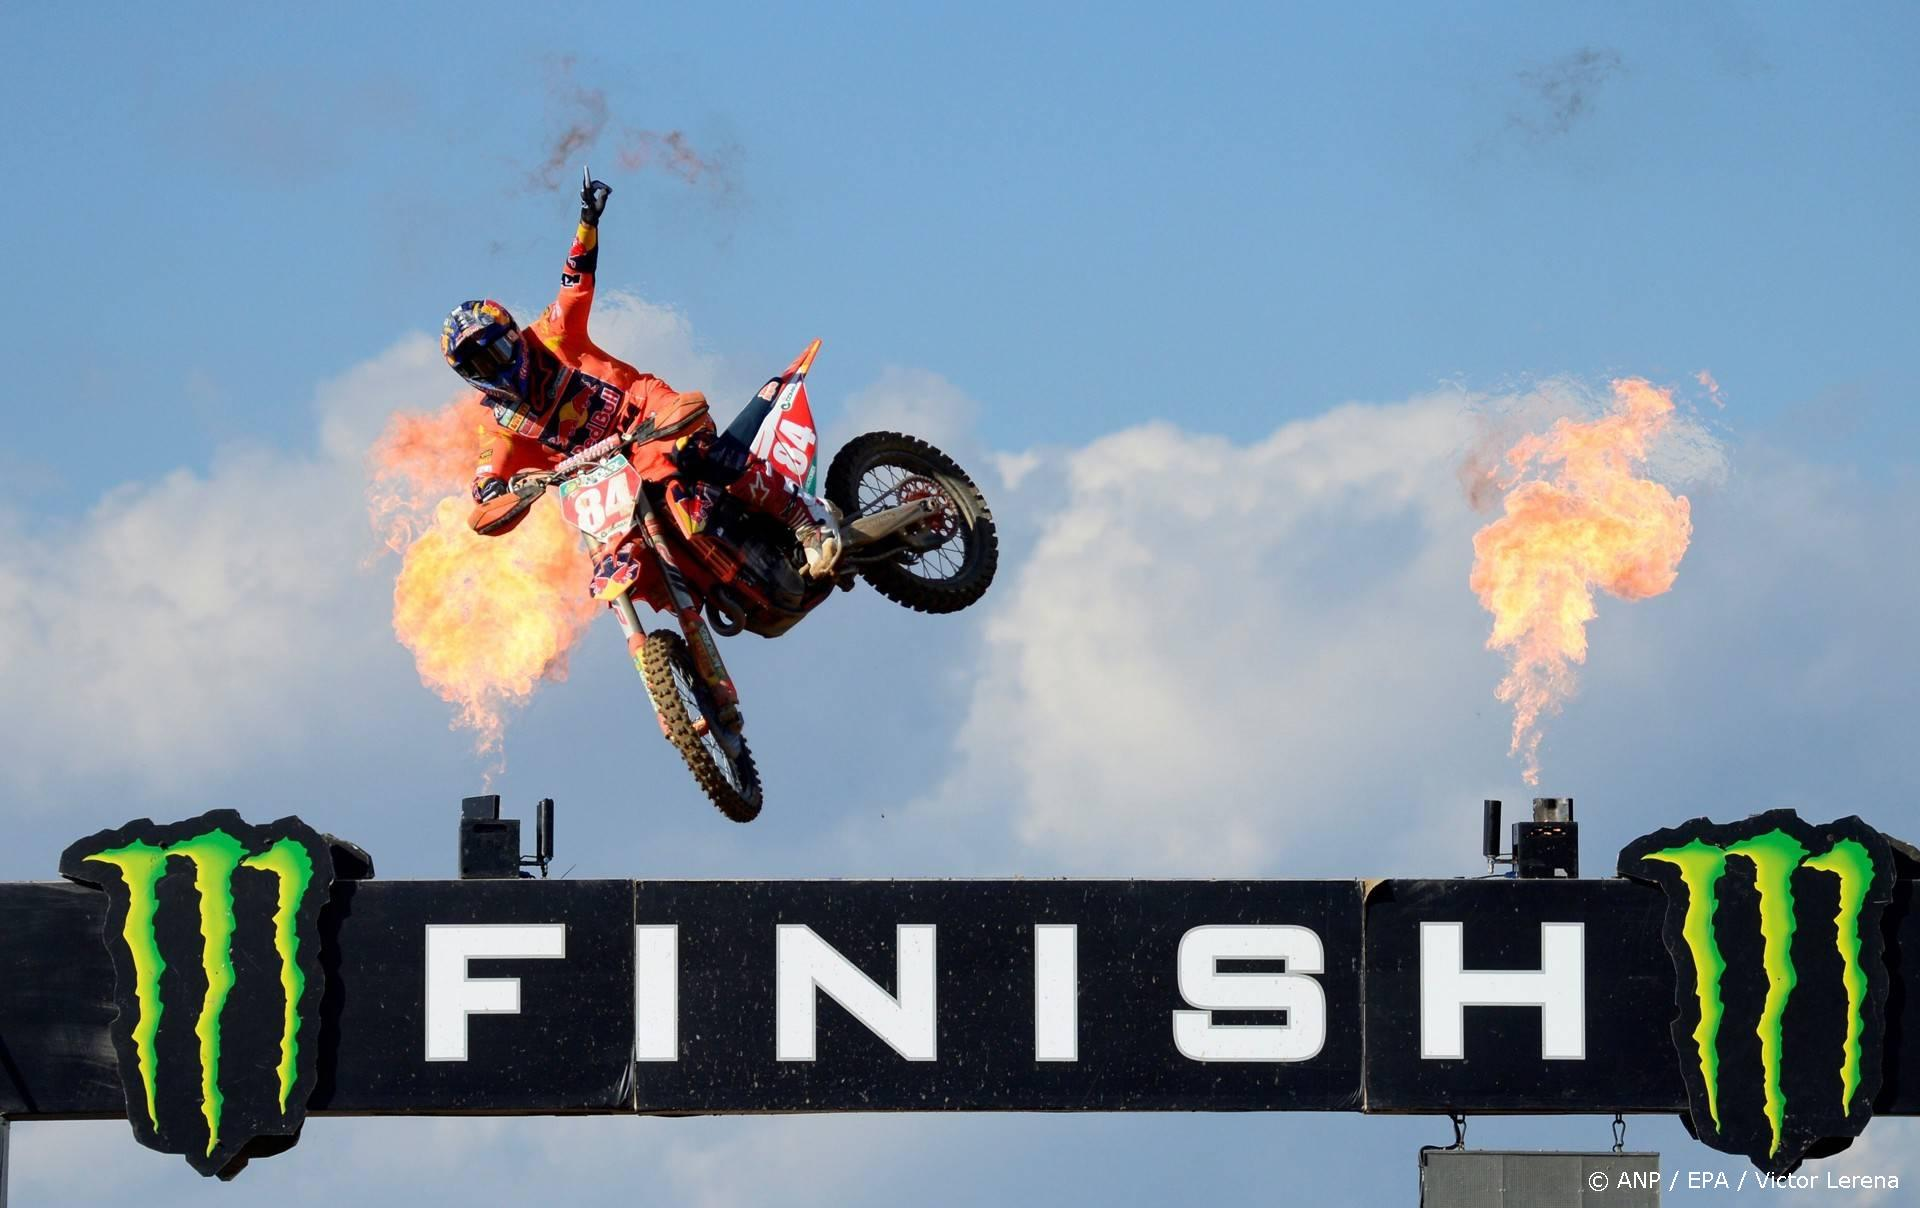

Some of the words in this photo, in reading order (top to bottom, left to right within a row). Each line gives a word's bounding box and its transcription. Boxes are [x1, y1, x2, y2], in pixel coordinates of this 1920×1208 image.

[773, 419, 816, 476] 84
[574, 471, 634, 534] 84
[423, 922, 1587, 1063] FINISH
